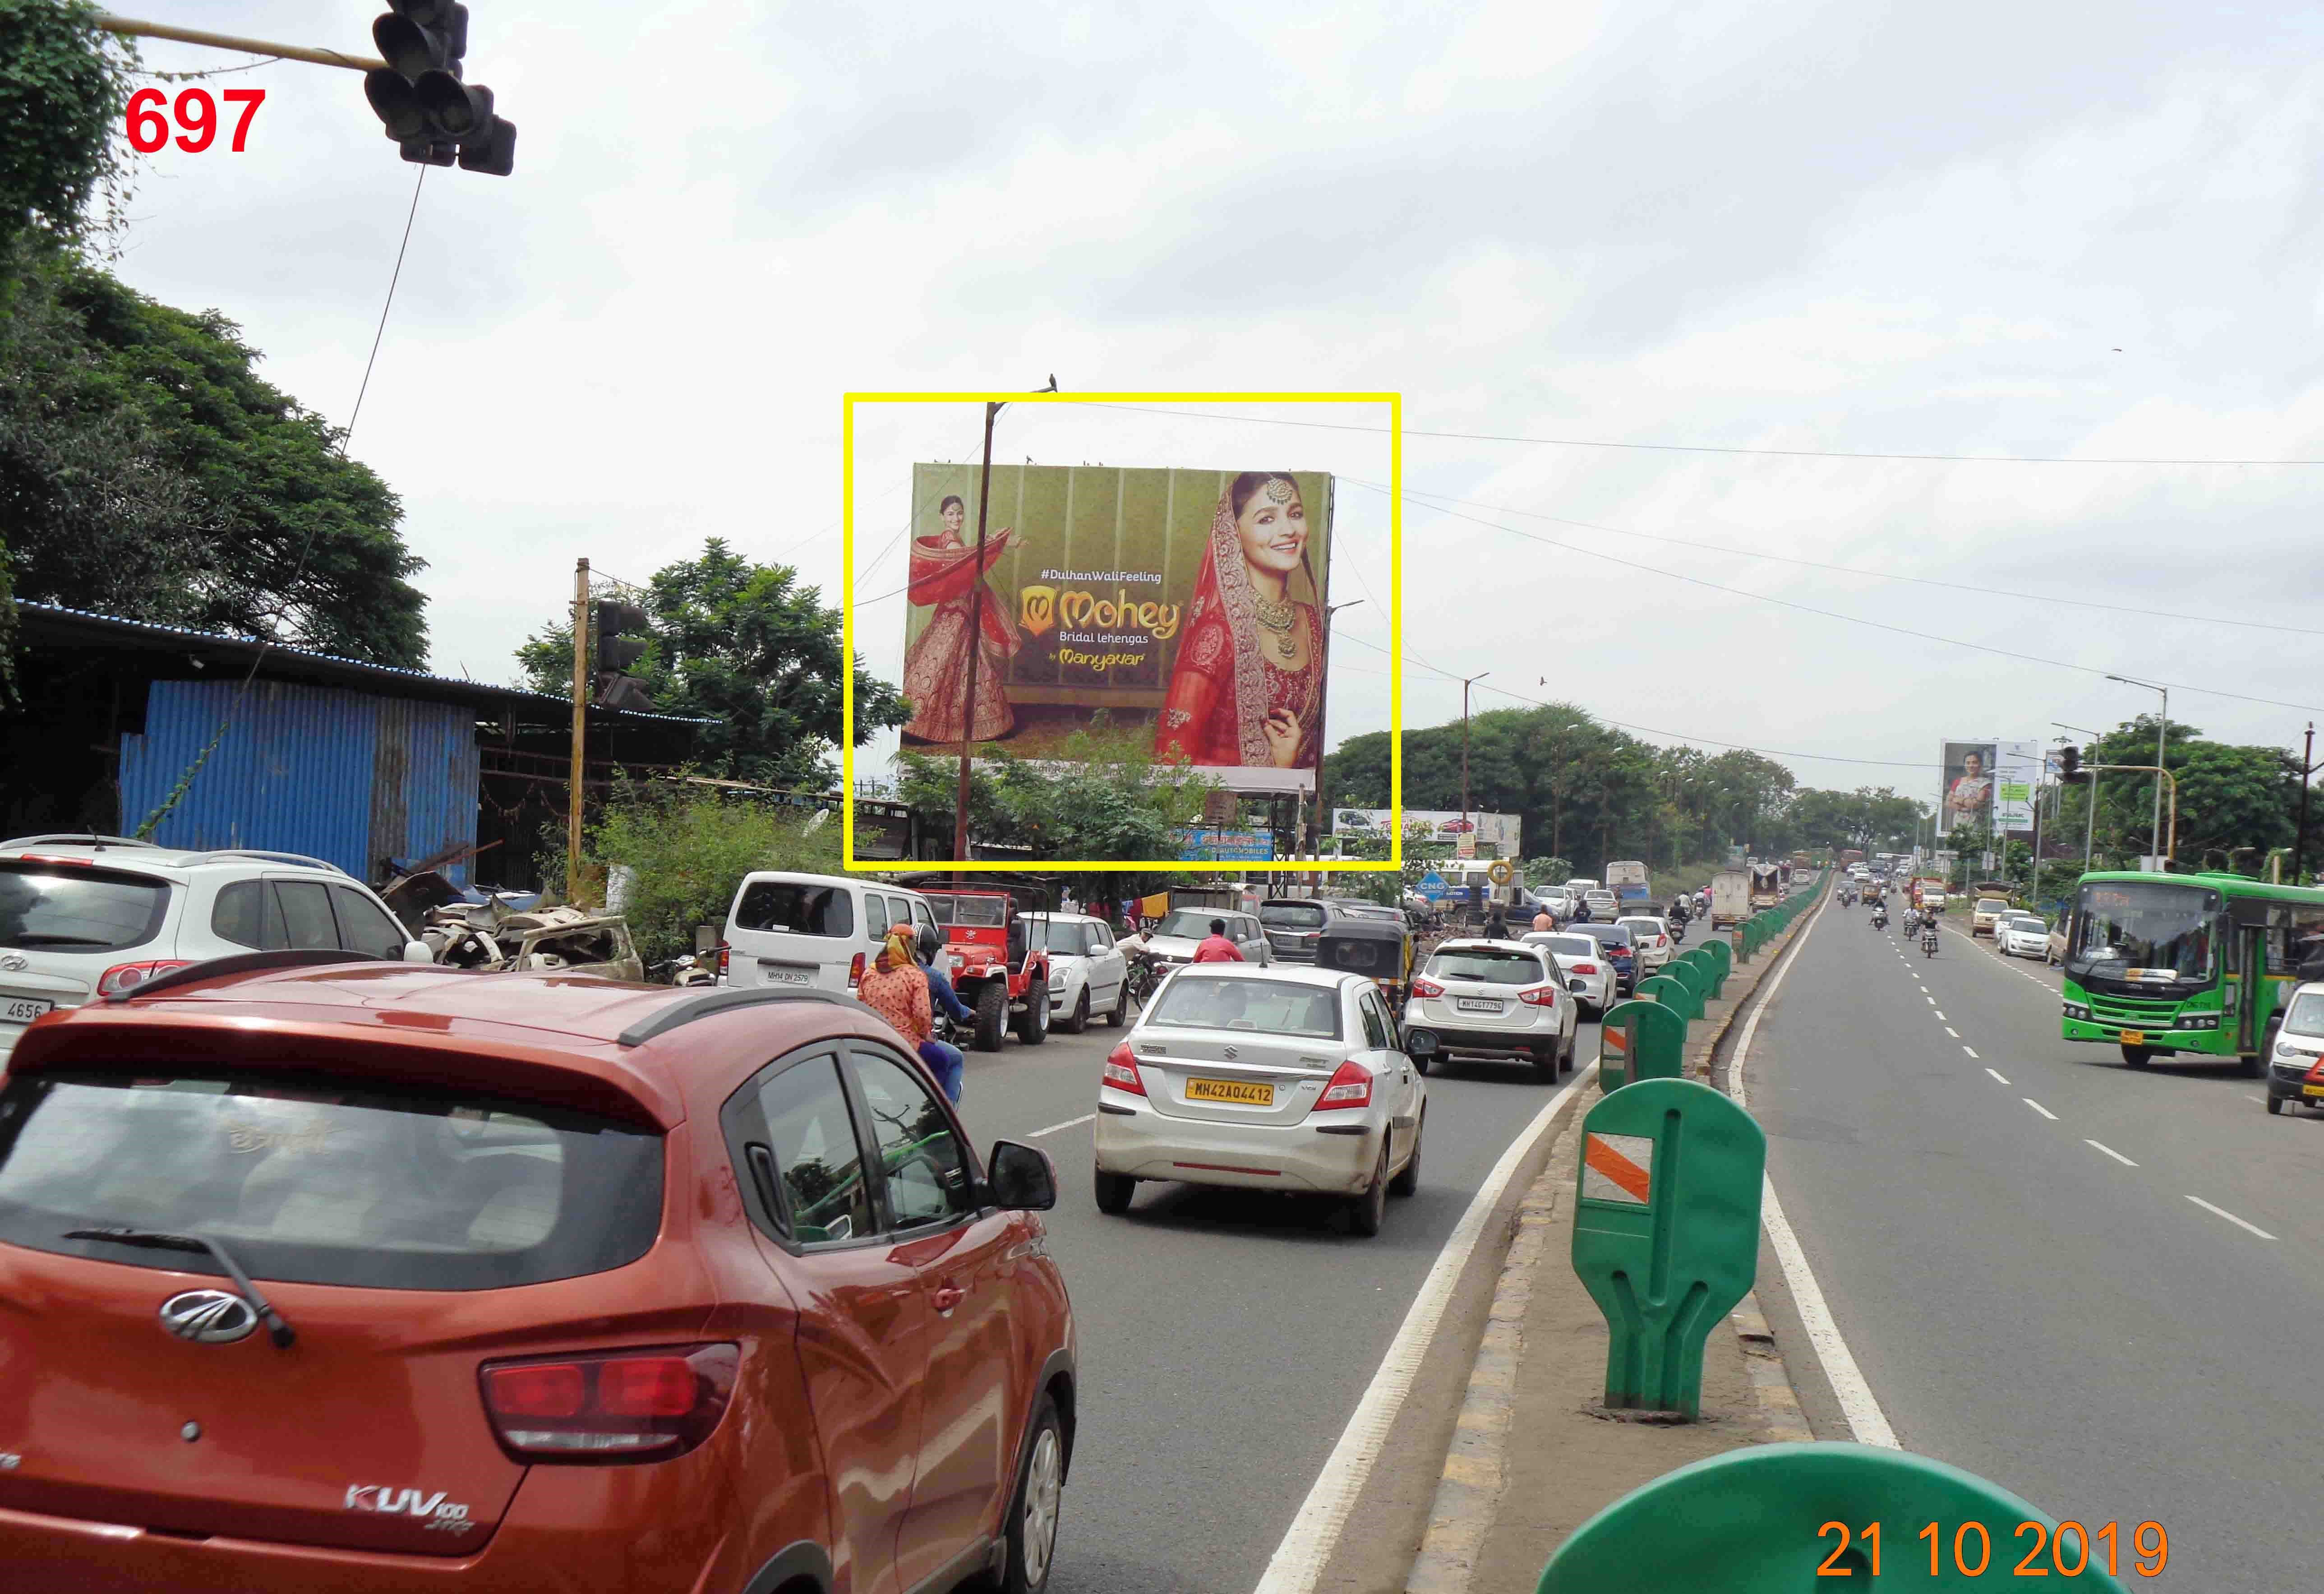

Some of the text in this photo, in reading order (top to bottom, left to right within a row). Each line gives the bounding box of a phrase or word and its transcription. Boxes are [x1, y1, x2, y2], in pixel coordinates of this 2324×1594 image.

[1041, 569, 1162, 584] #DulhanWaliFeeling
[1060, 631, 1148, 646] Bridal lehengas
[793, 974, 808, 982] 2579
[7, 1003, 43, 1018] 4656
